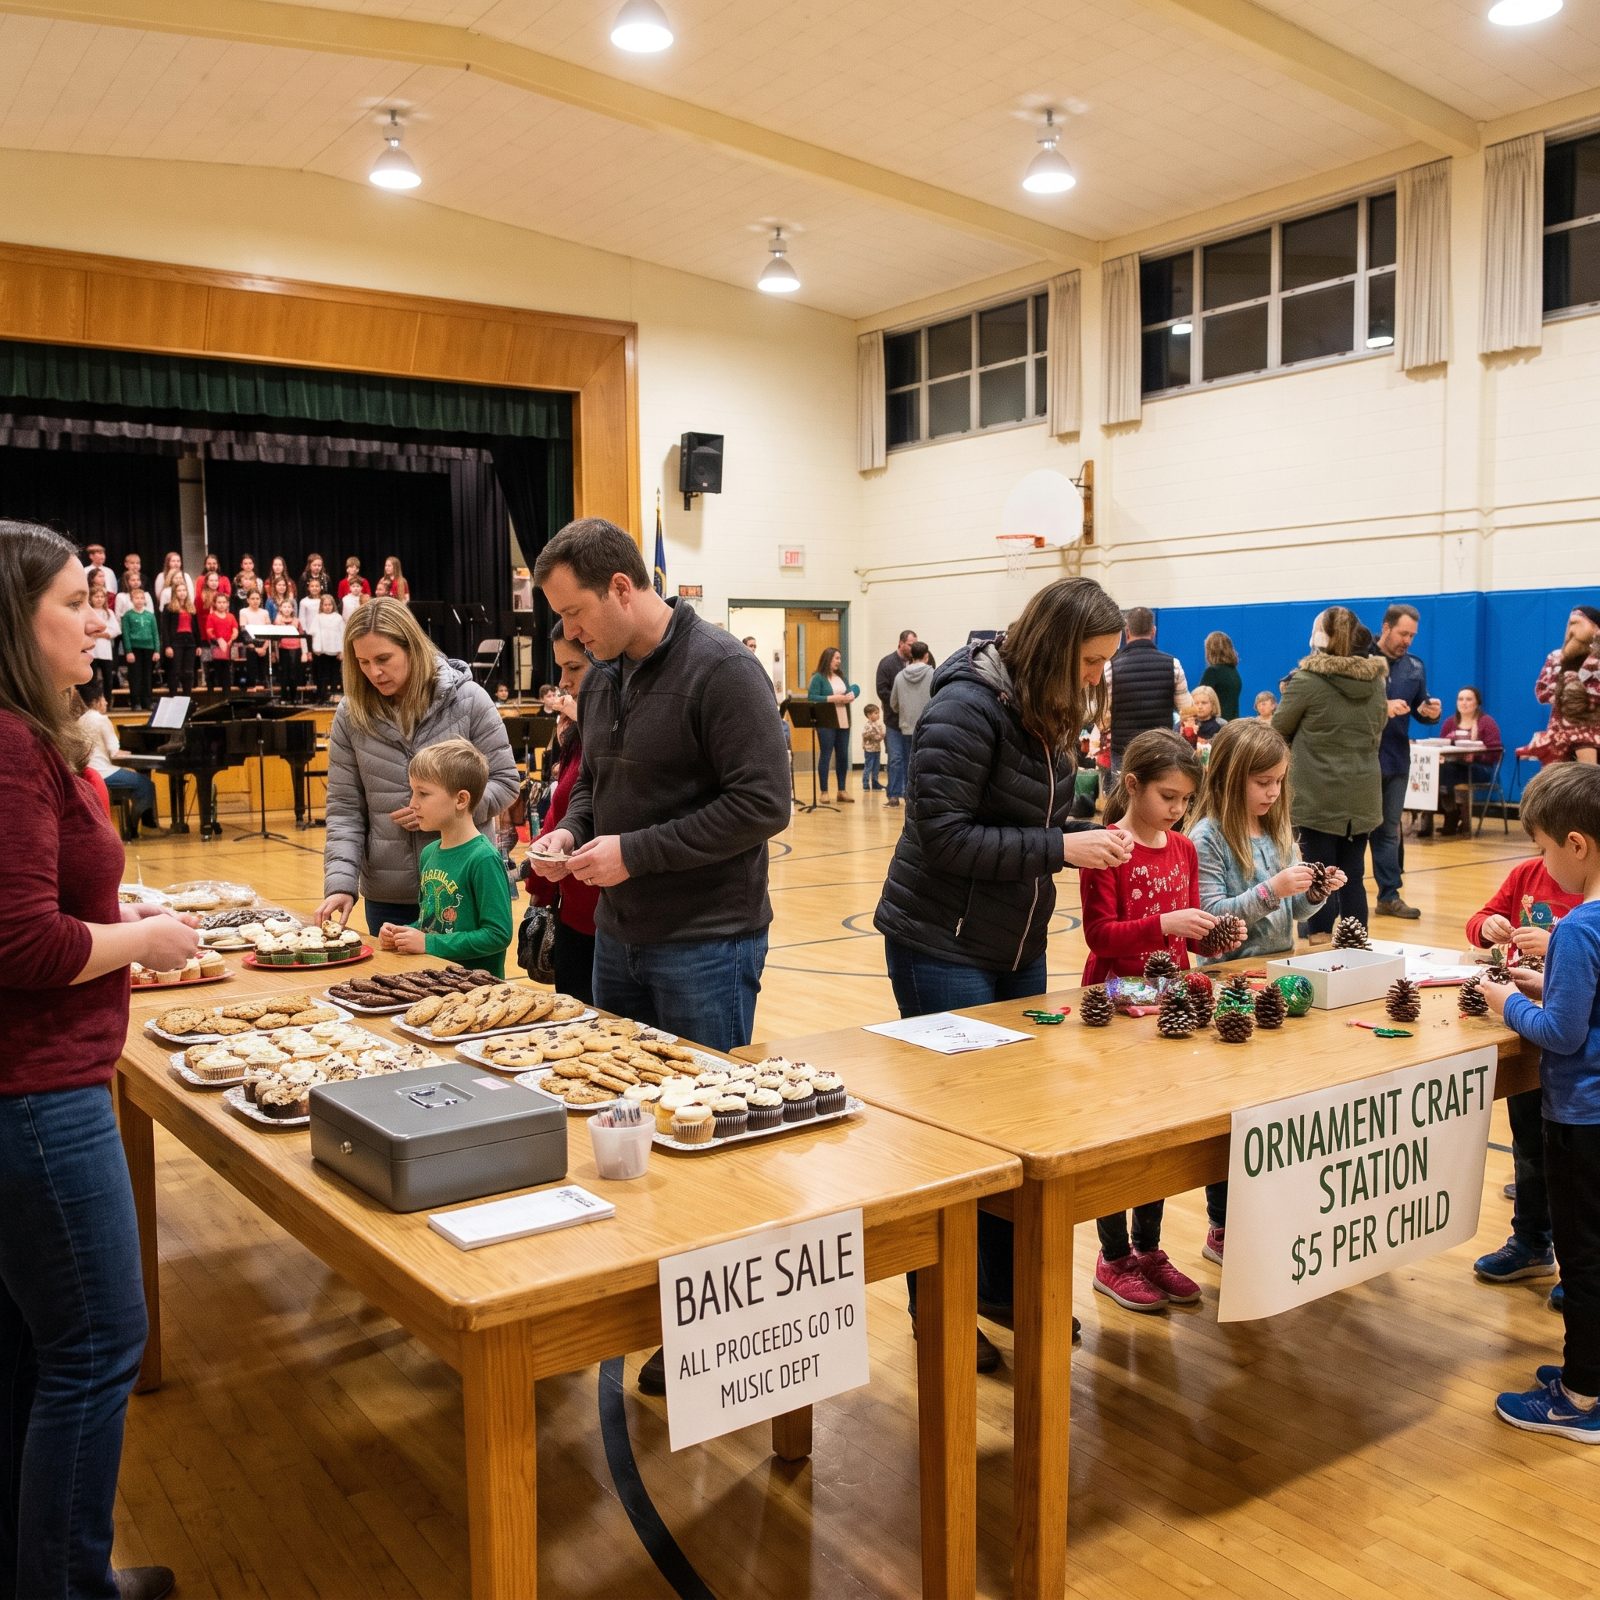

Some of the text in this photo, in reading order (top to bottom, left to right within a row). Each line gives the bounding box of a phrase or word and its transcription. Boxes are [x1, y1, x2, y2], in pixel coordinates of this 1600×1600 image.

[785, 551, 800, 564] EXIT
[1243, 1064, 1489, 1178] ORNAMENT CRAFT
[1319, 1136, 1428, 1215] STATION
[1291, 1190, 1450, 1286] $5 PER CHILD
[675, 1231, 854, 1327] BAKE SALE
[679, 1303, 854, 1380] ALL PROCEEDS GO TO
[721, 1353, 820, 1409] MUSIC DEPT
